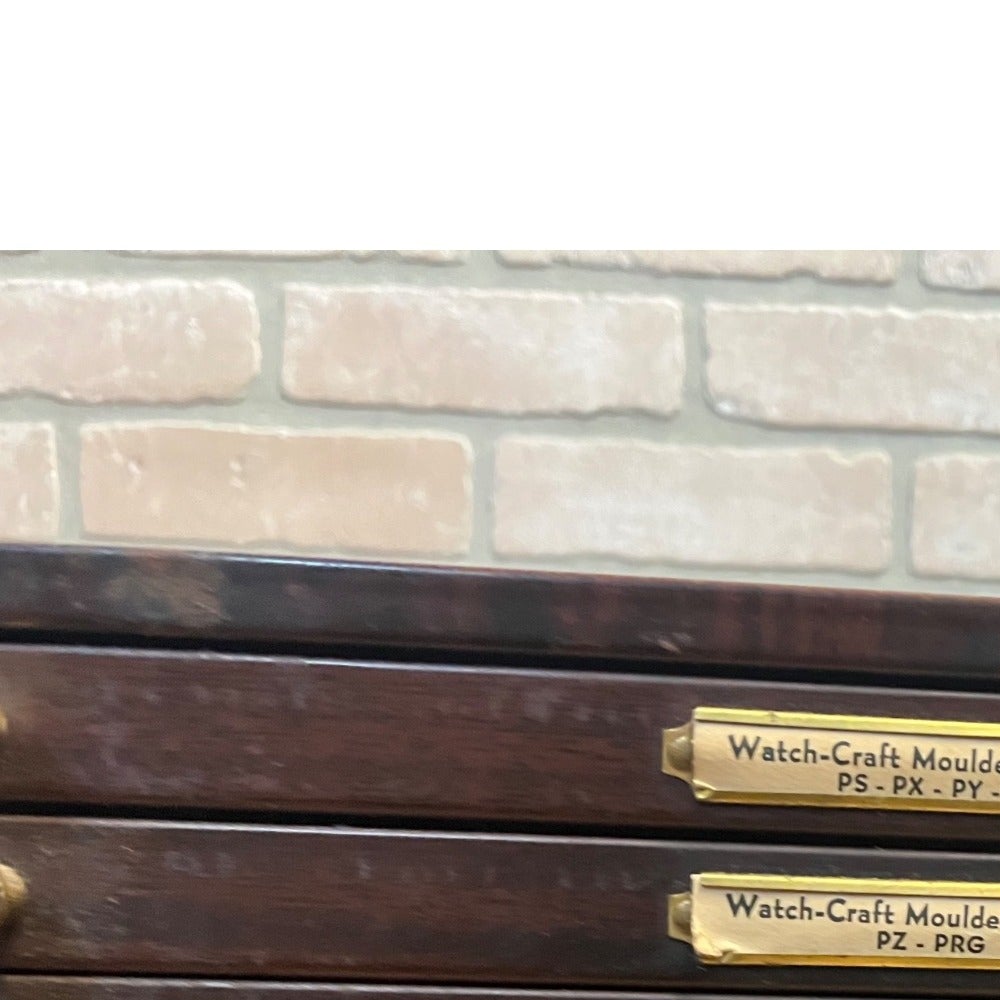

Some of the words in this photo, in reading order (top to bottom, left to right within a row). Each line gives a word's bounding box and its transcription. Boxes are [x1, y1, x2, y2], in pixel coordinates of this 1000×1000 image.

[728, 735, 900, 769] Watch-Craft
[837, 772, 868, 793] PS
[892, 776, 924, 796] PX
[952, 779, 984, 799] PY
[726, 893, 894, 925] Watch-Craft
[877, 930, 907, 951] PZ
[934, 933, 986, 954] PRG
